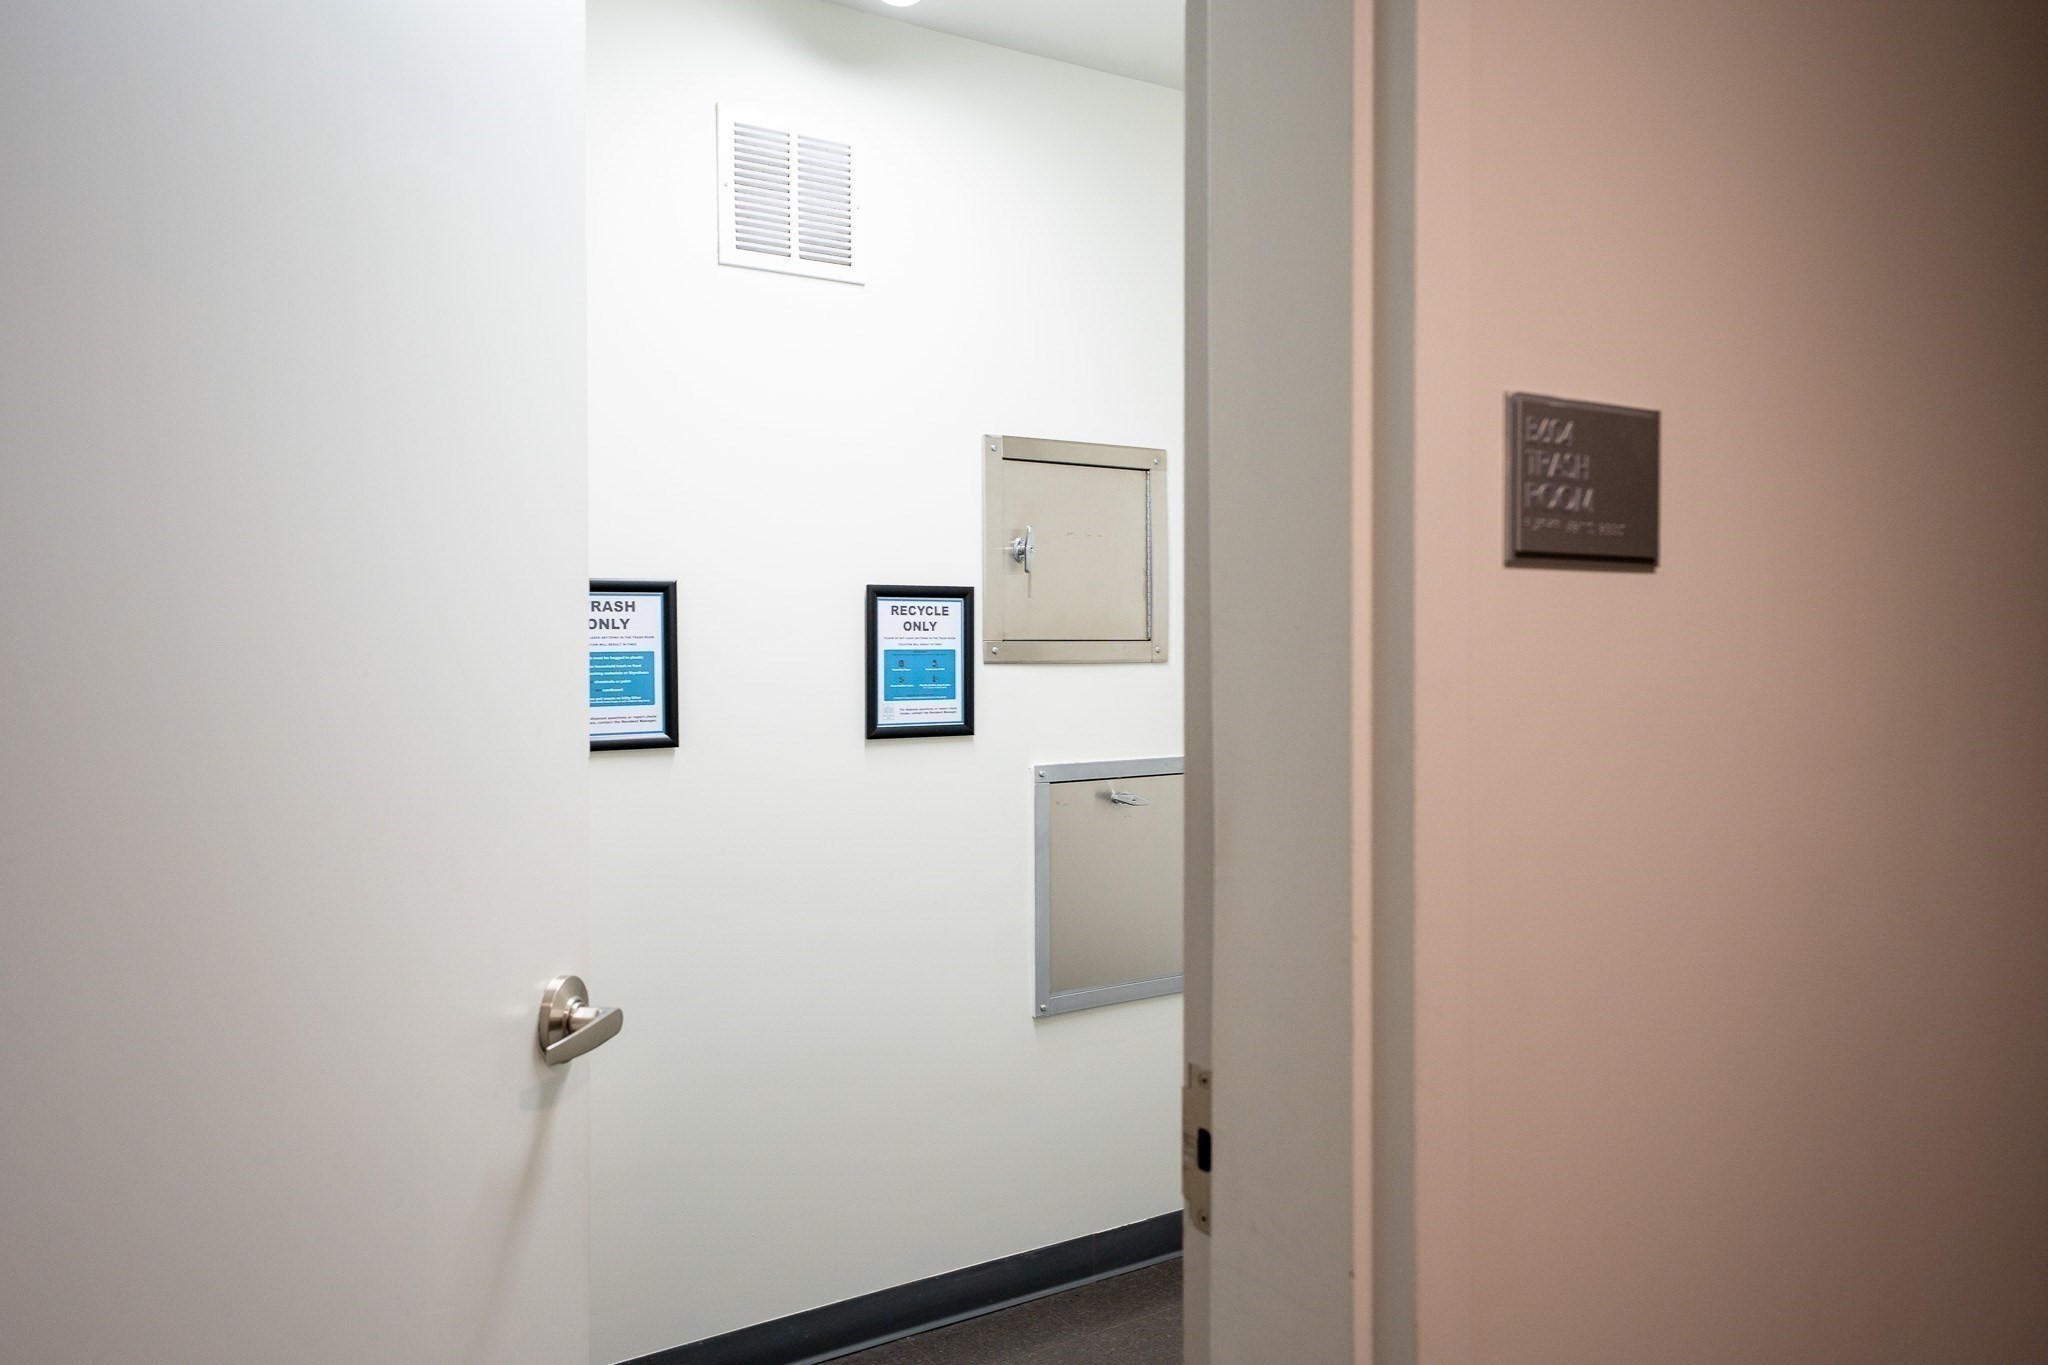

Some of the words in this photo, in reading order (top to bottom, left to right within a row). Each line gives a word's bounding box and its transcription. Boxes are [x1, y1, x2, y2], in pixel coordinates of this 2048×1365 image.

[1524, 448, 1591, 481] TRASH
[1524, 482, 1594, 512] ROOM
[589, 600, 636, 612] RASH
[890, 605, 949, 616] RECYCLE
[903, 621, 938, 631] ONLY
